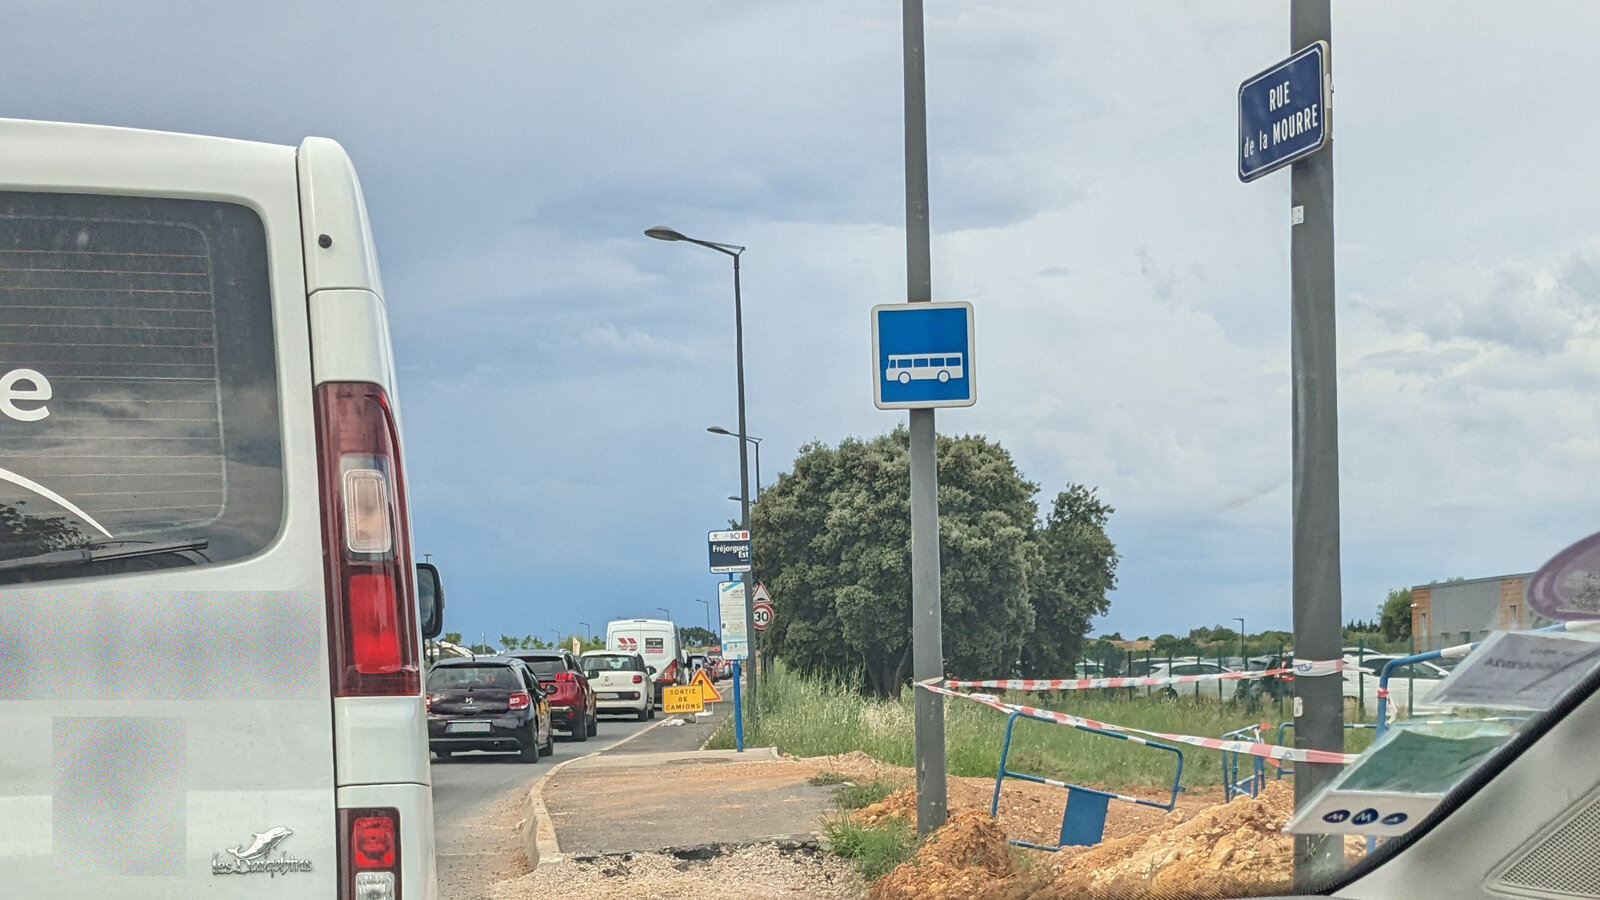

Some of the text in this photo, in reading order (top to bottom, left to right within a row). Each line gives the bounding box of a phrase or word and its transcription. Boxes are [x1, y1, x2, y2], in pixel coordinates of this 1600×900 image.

[1269, 81, 1290, 112] RUE
[1244, 104, 1318, 158] de la MOURRE
[712, 544, 749, 553] Fréjorgues
[754, 611, 769, 622] 30
